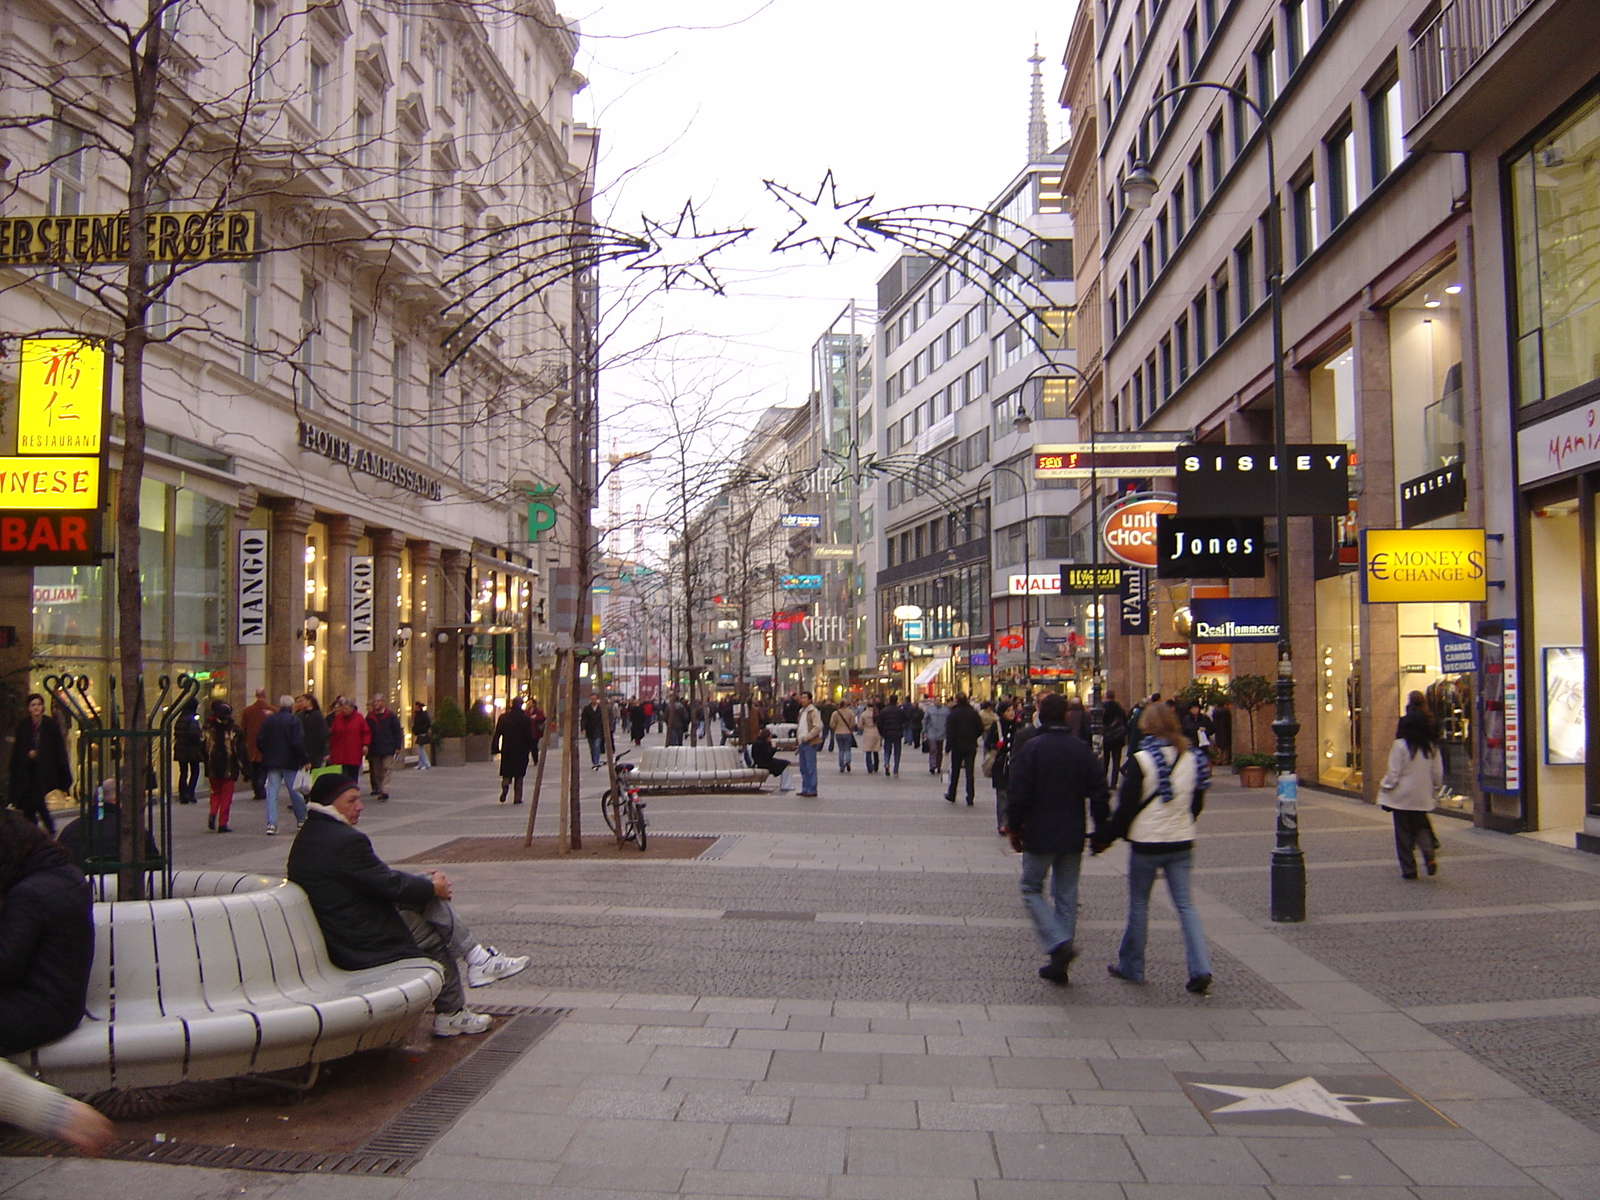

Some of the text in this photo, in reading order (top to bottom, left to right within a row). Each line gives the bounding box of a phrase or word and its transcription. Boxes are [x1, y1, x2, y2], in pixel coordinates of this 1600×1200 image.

[22, 435, 97, 447] RESTAURANT
[303, 423, 441, 501] HOTEL AMBASSADOR
[1184, 455, 1341, 472] SISLEY
[1404, 472, 1452, 500] SISLEY
[0, 516, 88, 551] BAR
[528, 503, 556, 541] P
[1170, 532, 1253, 560] Jones
[1394, 551, 1463, 566] MONEY
[242, 538, 264, 637] MANGO
[1394, 567, 1464, 581] CHANGE
[353, 563, 372, 645] MANGO
[802, 615, 846, 642] STEFFL
[1444, 642, 1472, 652] CHANGE
